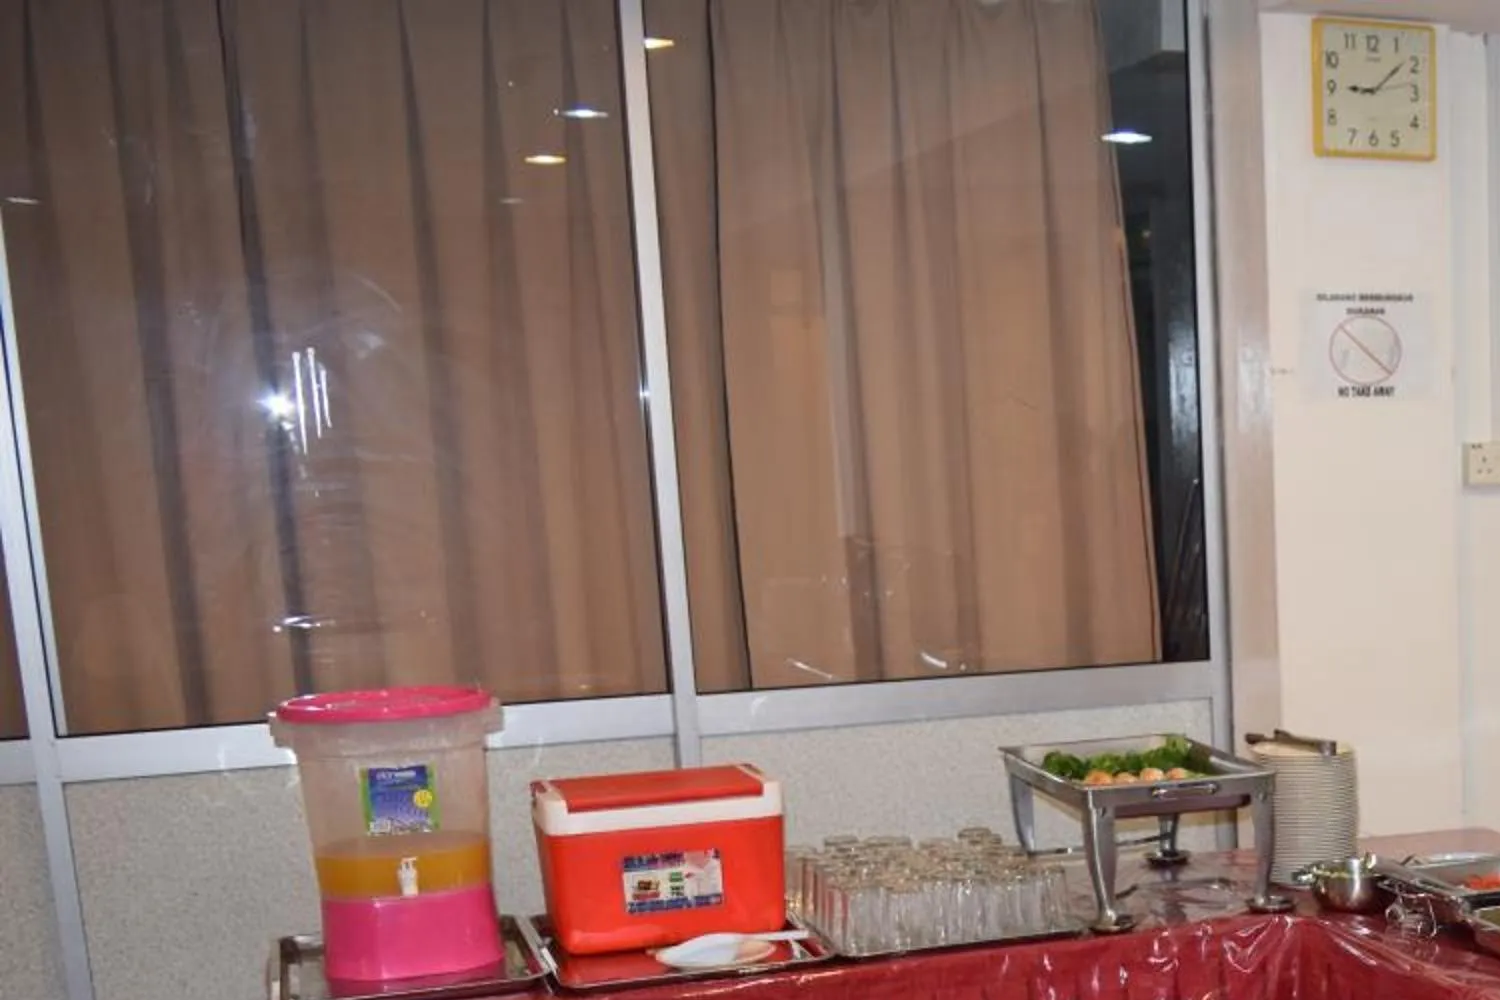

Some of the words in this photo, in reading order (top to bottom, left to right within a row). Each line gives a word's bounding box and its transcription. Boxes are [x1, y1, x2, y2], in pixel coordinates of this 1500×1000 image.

[1344, 32, 1356, 49] 11
[1366, 35, 1379, 53] 12
[1393, 37, 1399, 53] 1
[1325, 50, 1339, 69] 10
[1410, 55, 1419, 74] 2
[1327, 79, 1337, 95] 9
[1410, 84, 1419, 102] 3
[1327, 109, 1337, 126] 8
[1409, 115, 1419, 129] 4
[1347, 128, 1357, 145] 7
[1368, 130, 1379, 147] 6
[1390, 131, 1399, 147] 5
